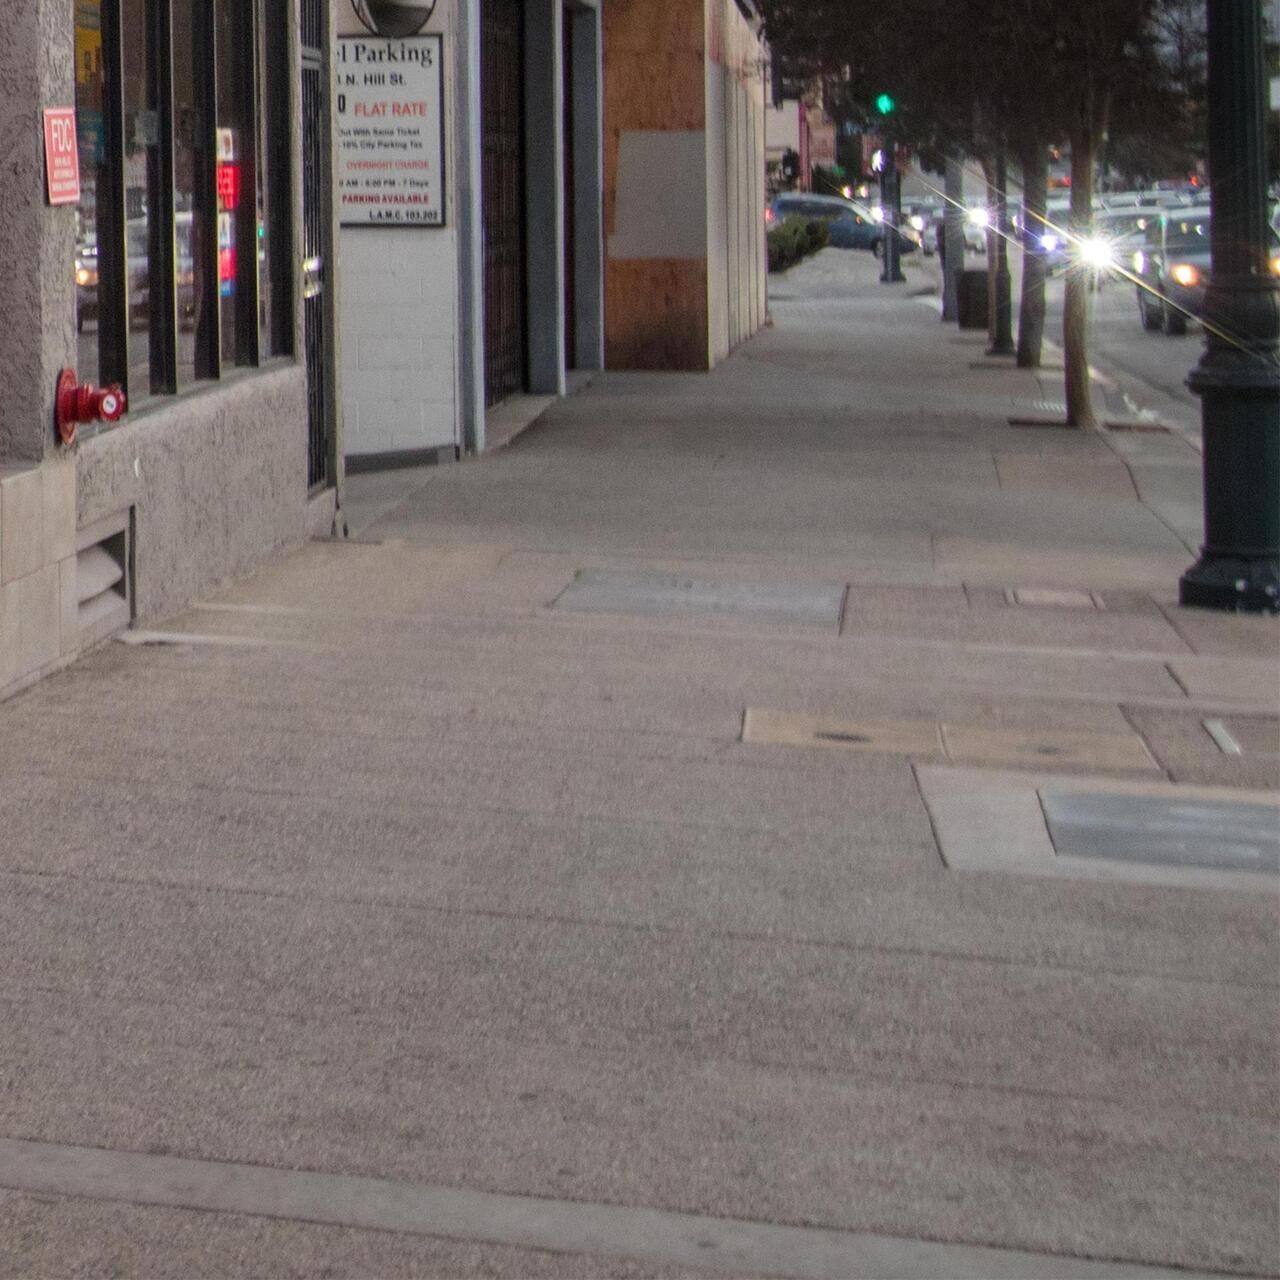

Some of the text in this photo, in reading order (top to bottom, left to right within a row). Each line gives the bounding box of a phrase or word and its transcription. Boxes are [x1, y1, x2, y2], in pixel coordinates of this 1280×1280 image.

[354, 42, 432, 68] Parking
[364, 73, 385, 86] Hill
[354, 102, 387, 117] FLAT
[392, 101, 427, 117] RATE
[51, 118, 73, 153] FDC
[342, 194, 429, 205] PARKING AVAILABLE
